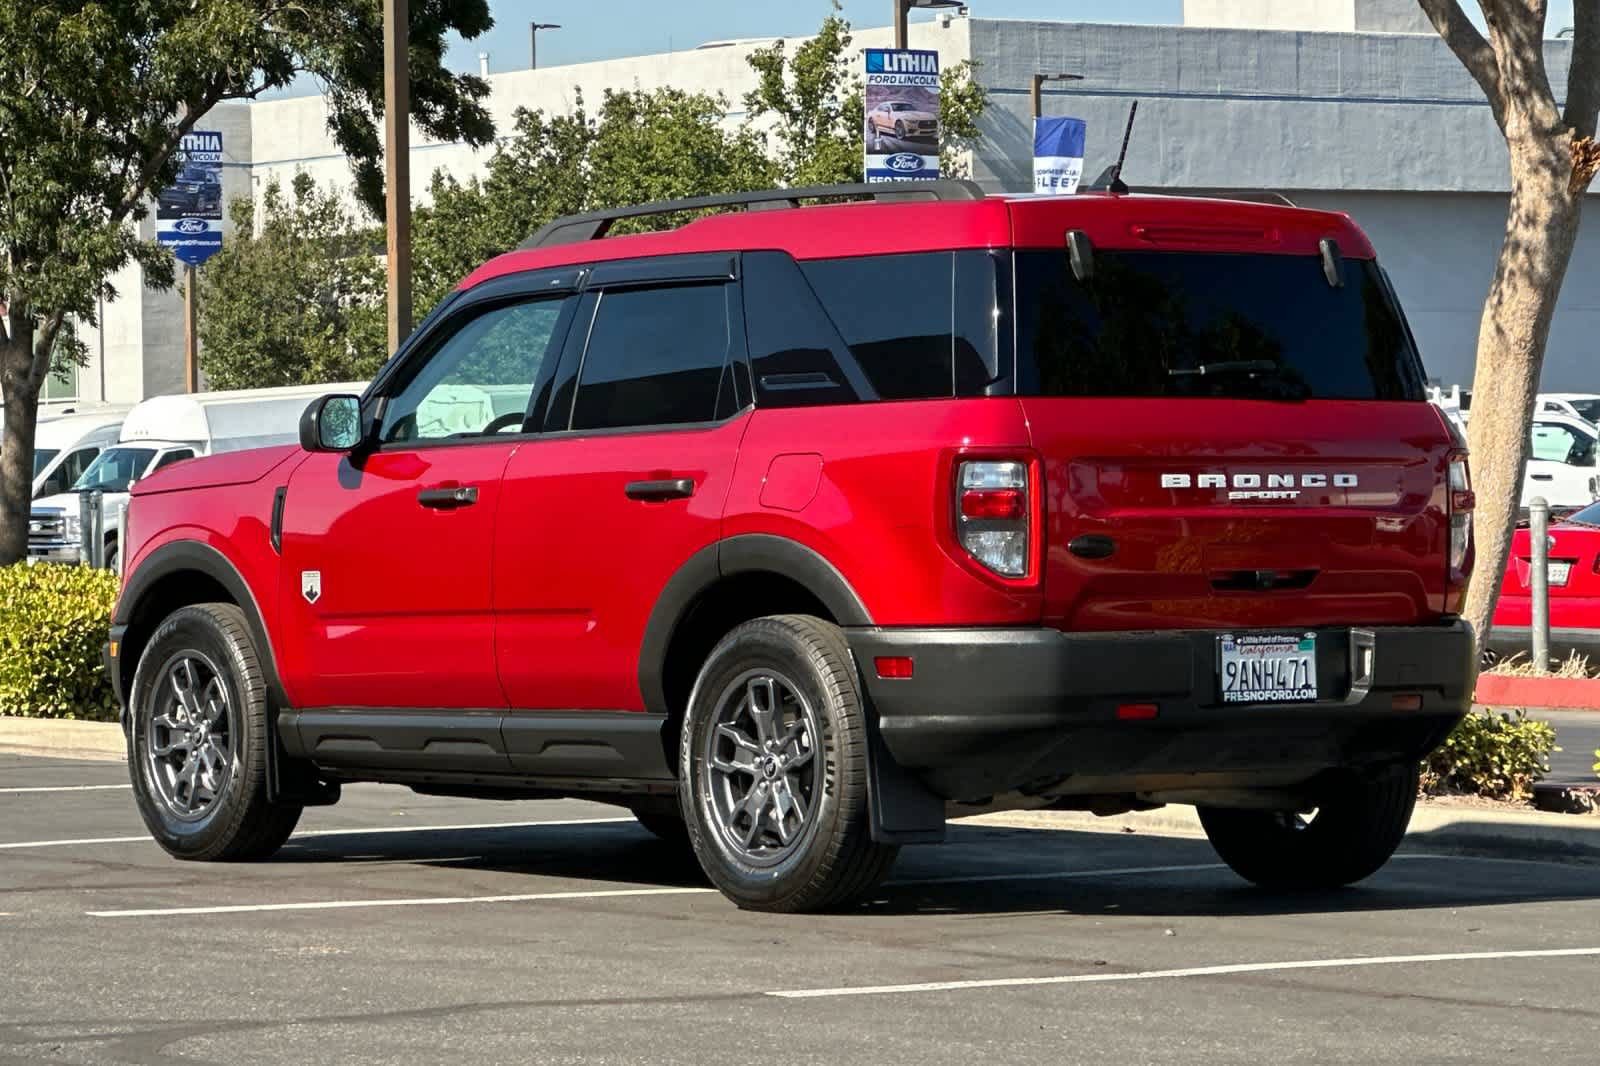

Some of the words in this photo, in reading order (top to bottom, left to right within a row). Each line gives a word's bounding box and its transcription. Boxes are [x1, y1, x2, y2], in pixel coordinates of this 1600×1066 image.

[884, 53, 937, 73] LITHIA
[868, 75, 897, 84] FORD
[898, 76, 937, 85] LINCOLN
[179, 135, 221, 151] ITHIA
[892, 156, 919, 168] Ford
[180, 221, 204, 231] Ford
[1161, 474, 1358, 488] BRONCO
[1228, 491, 1300, 500] SPORT
[1240, 645, 1299, 657] California
[1226, 659, 1312, 690] 9ANH471
[1224, 689, 1317, 701] FRESNOFORD.COM
